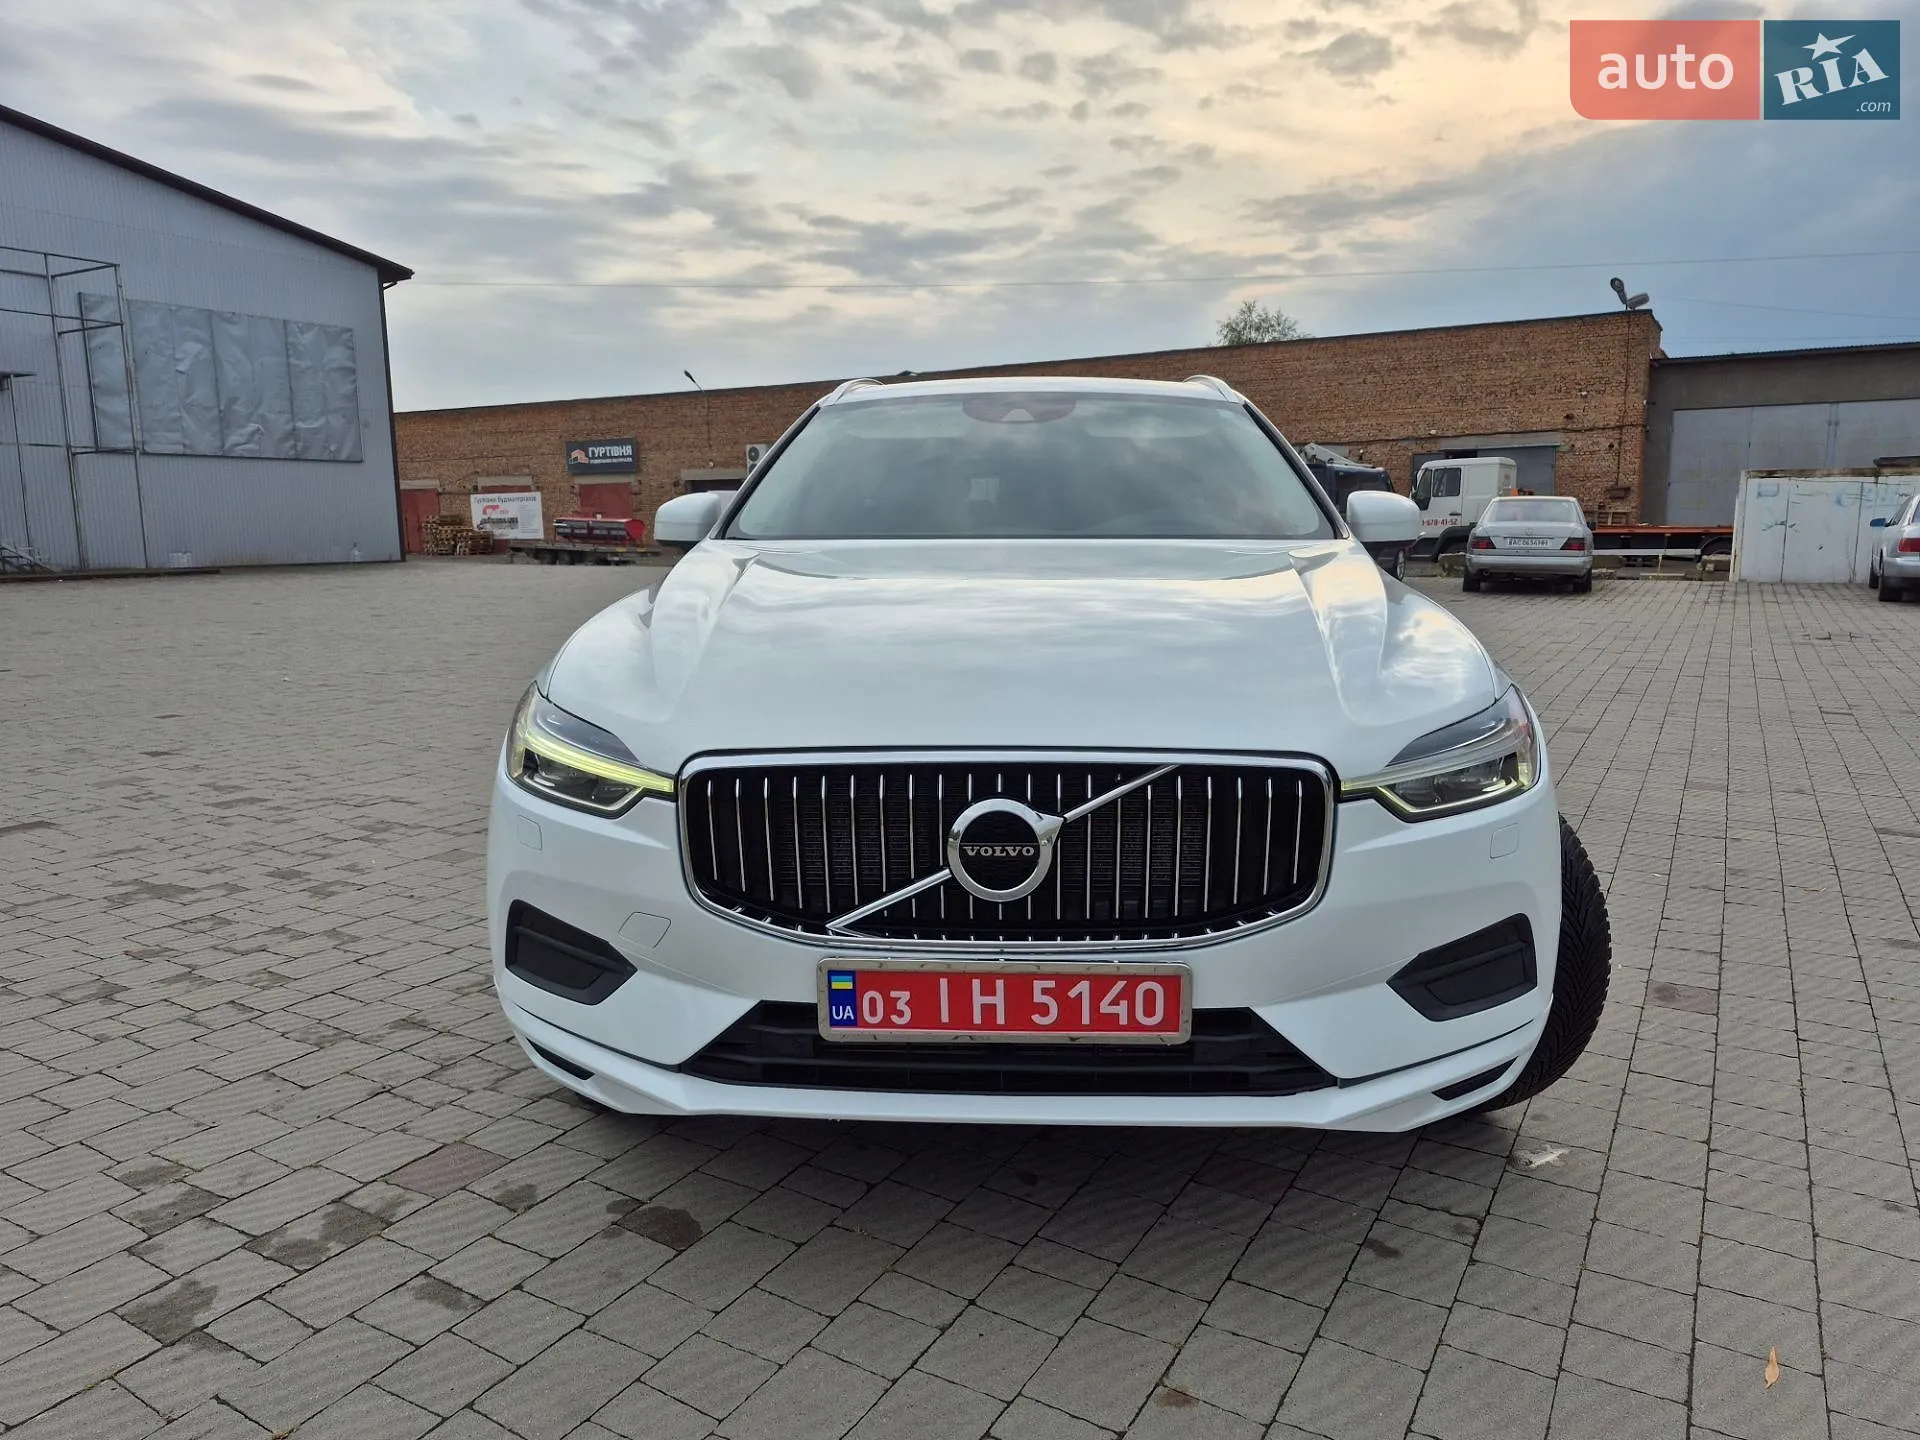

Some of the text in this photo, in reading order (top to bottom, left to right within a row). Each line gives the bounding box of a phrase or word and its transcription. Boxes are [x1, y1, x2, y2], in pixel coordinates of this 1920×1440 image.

[588, 445, 633, 457] ГУРТІВНЯ
[962, 845, 1036, 858] VOLVO
[861, 990, 912, 1025] 03
[1030, 979, 1165, 1026] 5140
[831, 1004, 854, 1021] UA
